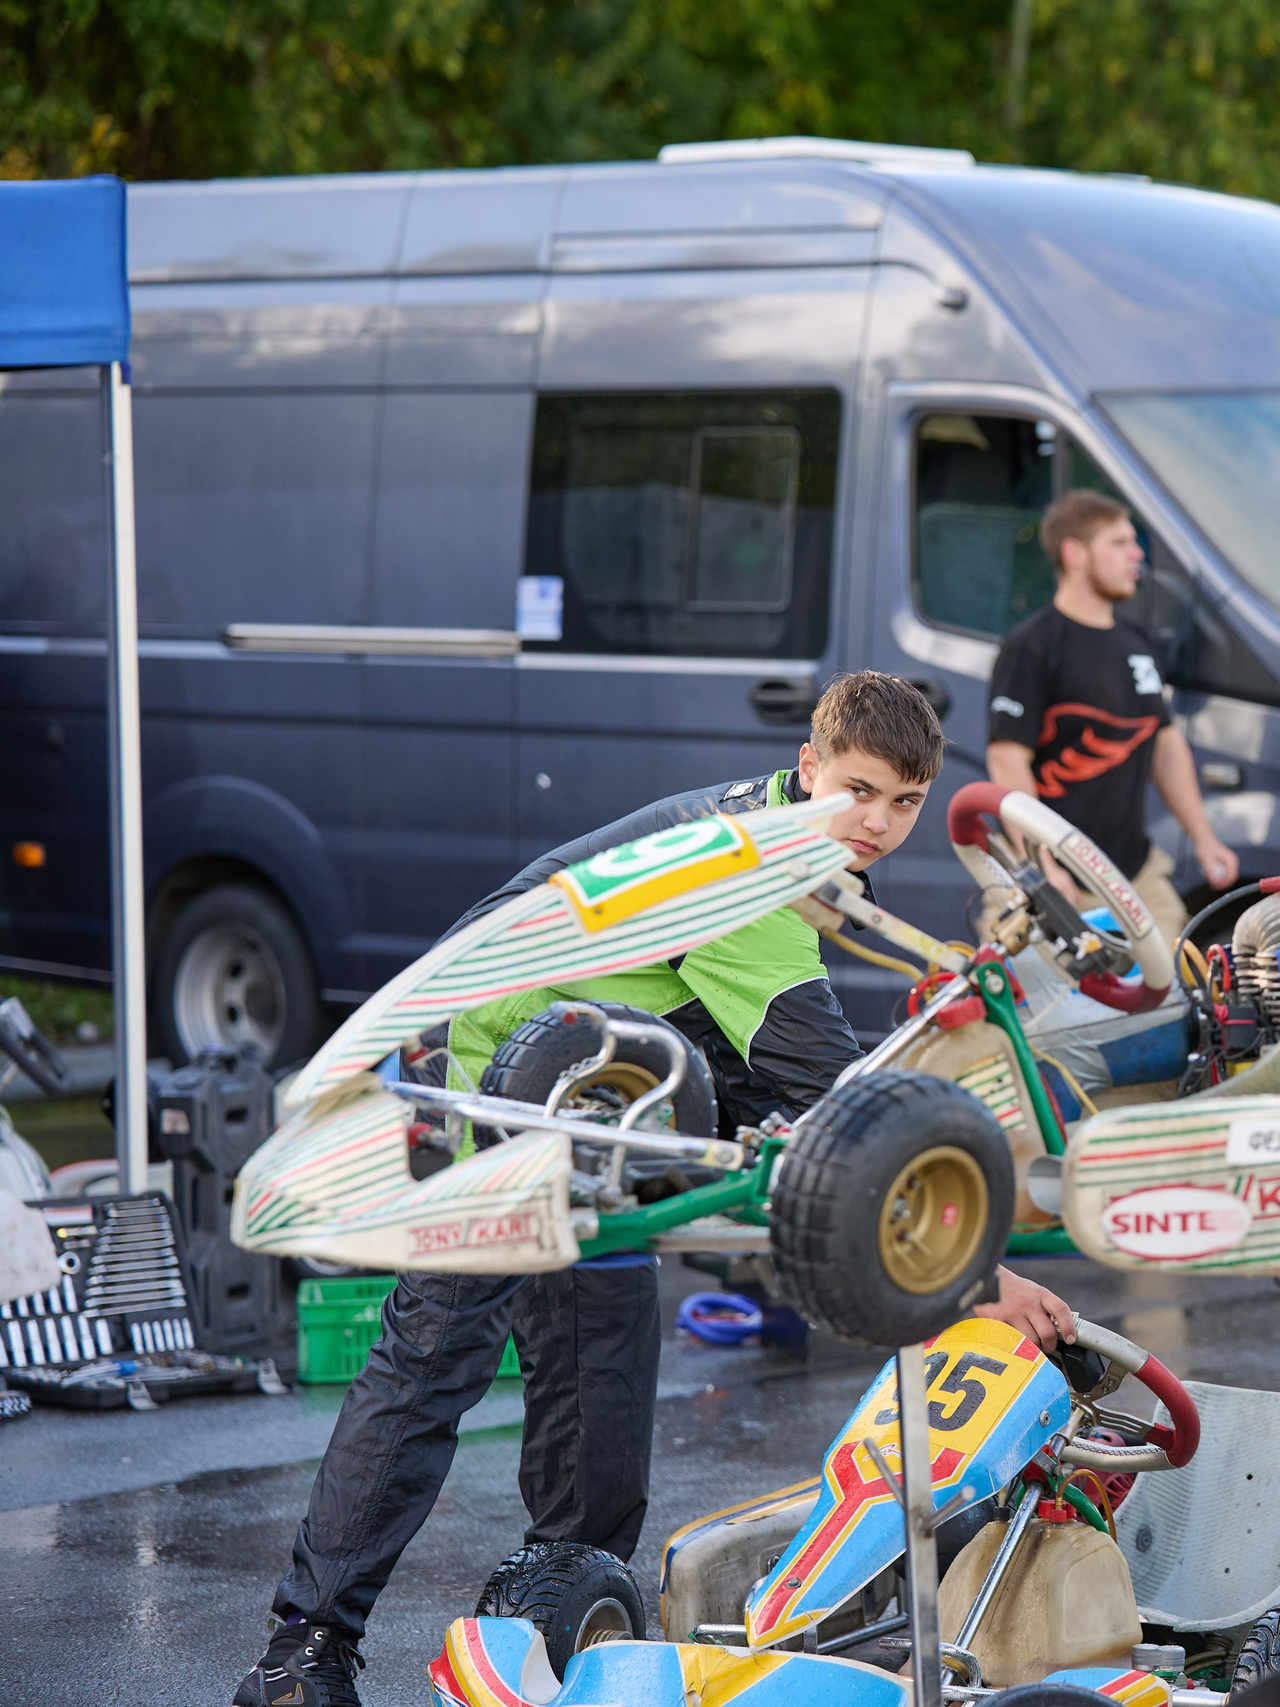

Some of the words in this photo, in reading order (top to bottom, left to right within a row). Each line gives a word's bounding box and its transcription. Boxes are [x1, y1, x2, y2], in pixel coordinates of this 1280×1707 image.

[410, 1222, 461, 1253] TONY
[476, 1212, 536, 1241] KART
[1111, 1210, 1228, 1235] SINTE
